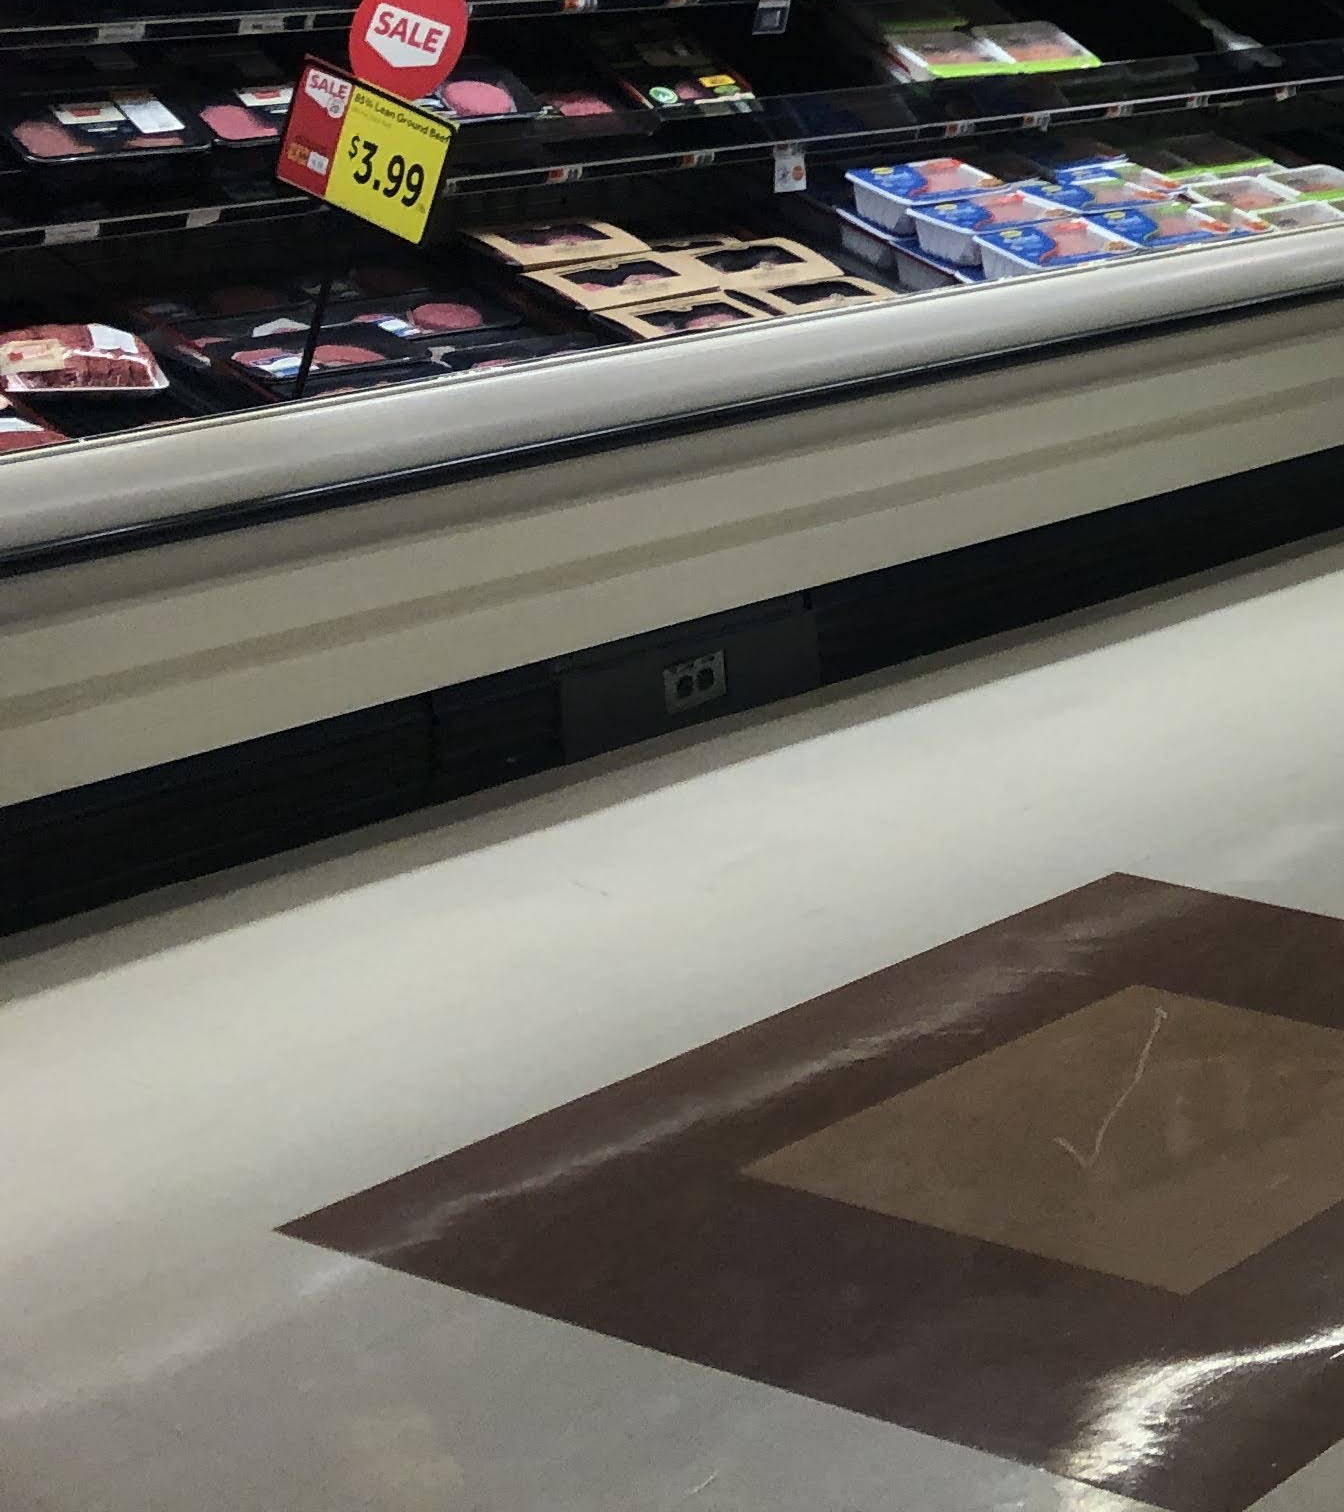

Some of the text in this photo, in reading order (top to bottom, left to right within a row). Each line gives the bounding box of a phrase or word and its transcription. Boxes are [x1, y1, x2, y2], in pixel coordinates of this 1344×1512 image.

[374, 10, 445, 54] SALE
[309, 74, 348, 100] SALE
[374, 103, 396, 120] Lean
[396, 113, 429, 135] Ground
[347, 134, 425, 208] $3.99
